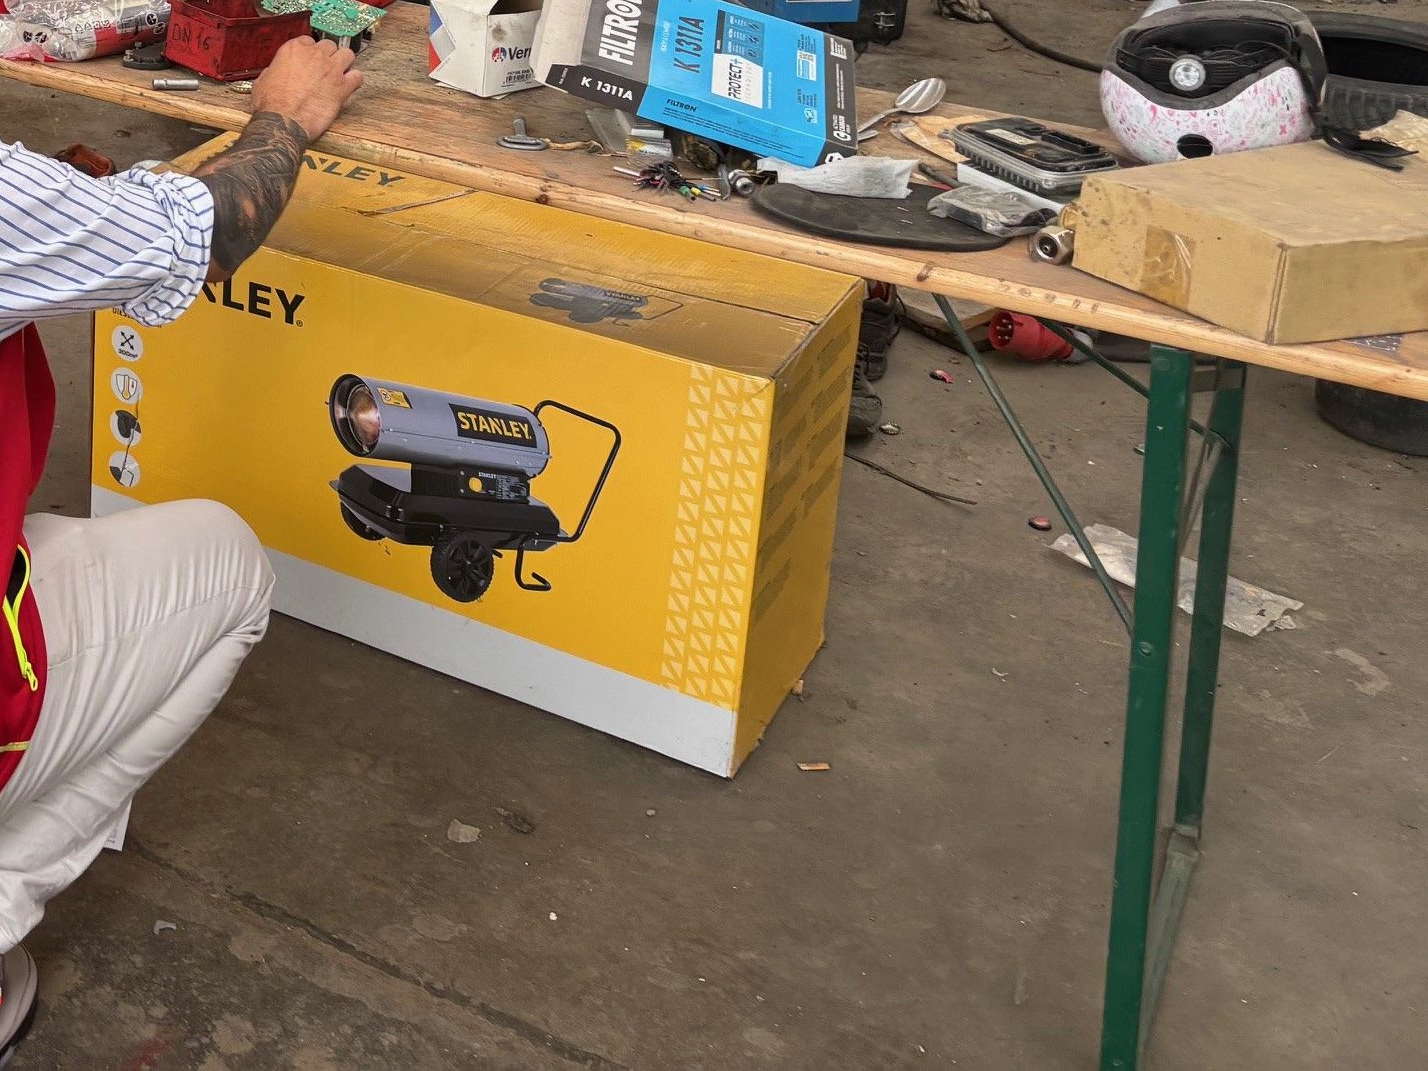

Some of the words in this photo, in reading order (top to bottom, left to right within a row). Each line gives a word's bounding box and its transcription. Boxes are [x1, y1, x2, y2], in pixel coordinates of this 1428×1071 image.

[675, 16, 704, 58] 1311A
[673, 58, 701, 74] K
[580, 76, 594, 88] K
[596, 81, 634, 101] 1311A
[666, 98, 697, 113] FILTRON
[457, 411, 531, 440] STANLEY
